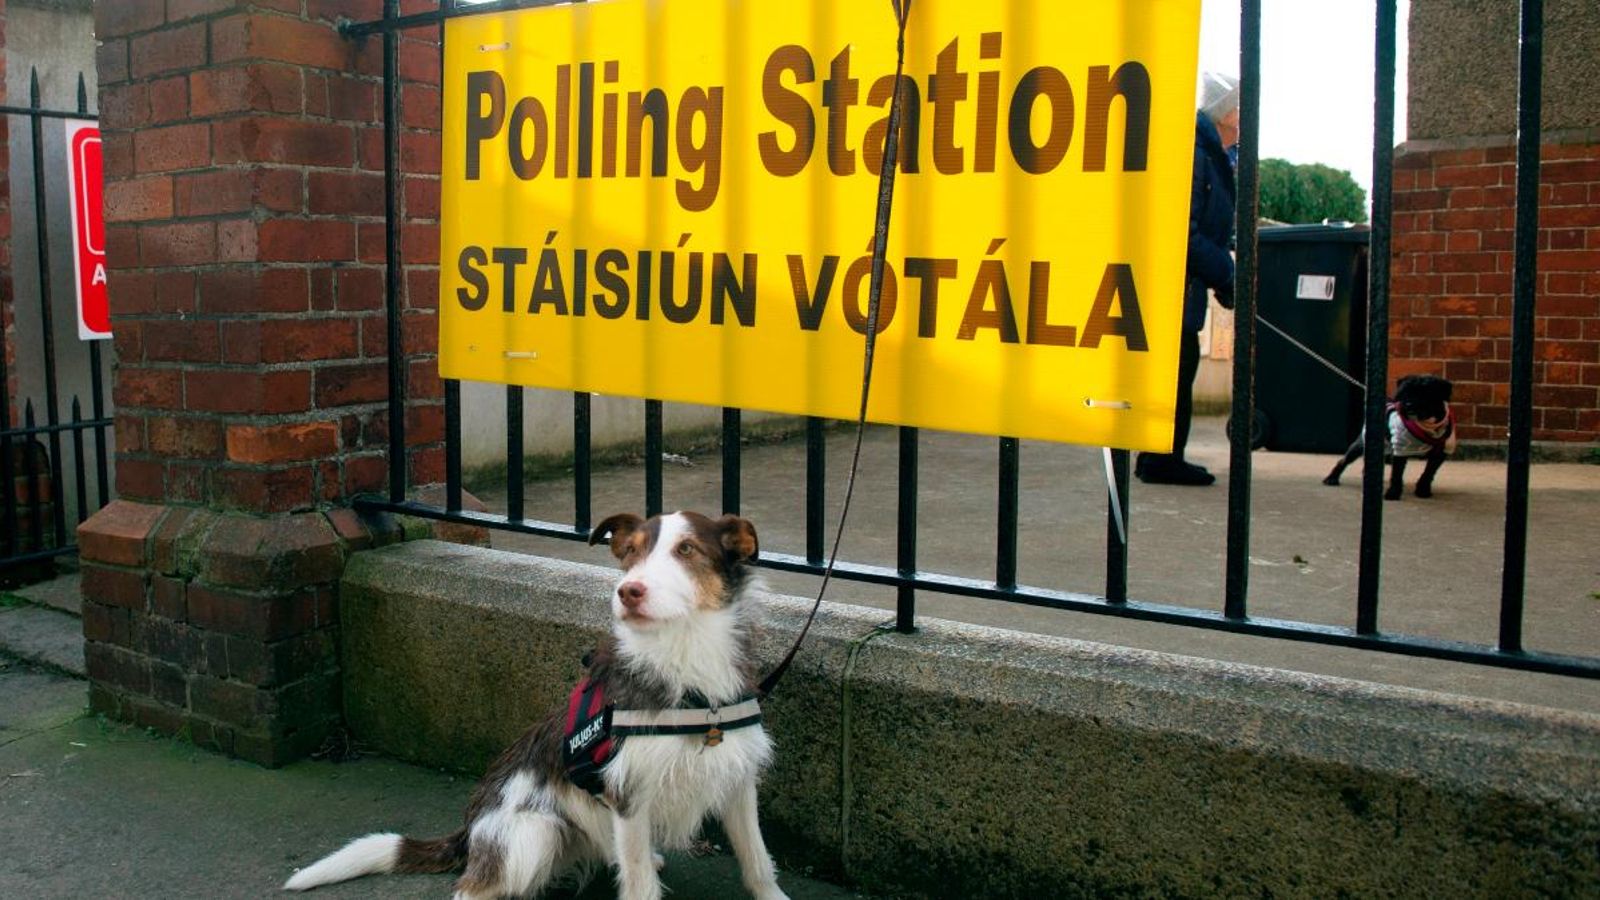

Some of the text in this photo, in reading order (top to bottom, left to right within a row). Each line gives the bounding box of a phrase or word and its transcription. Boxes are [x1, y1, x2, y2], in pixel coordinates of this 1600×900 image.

[465, 32, 1152, 211] Polling Station
[456, 230, 1149, 351] STÁISIÚN VÓTÁLA
